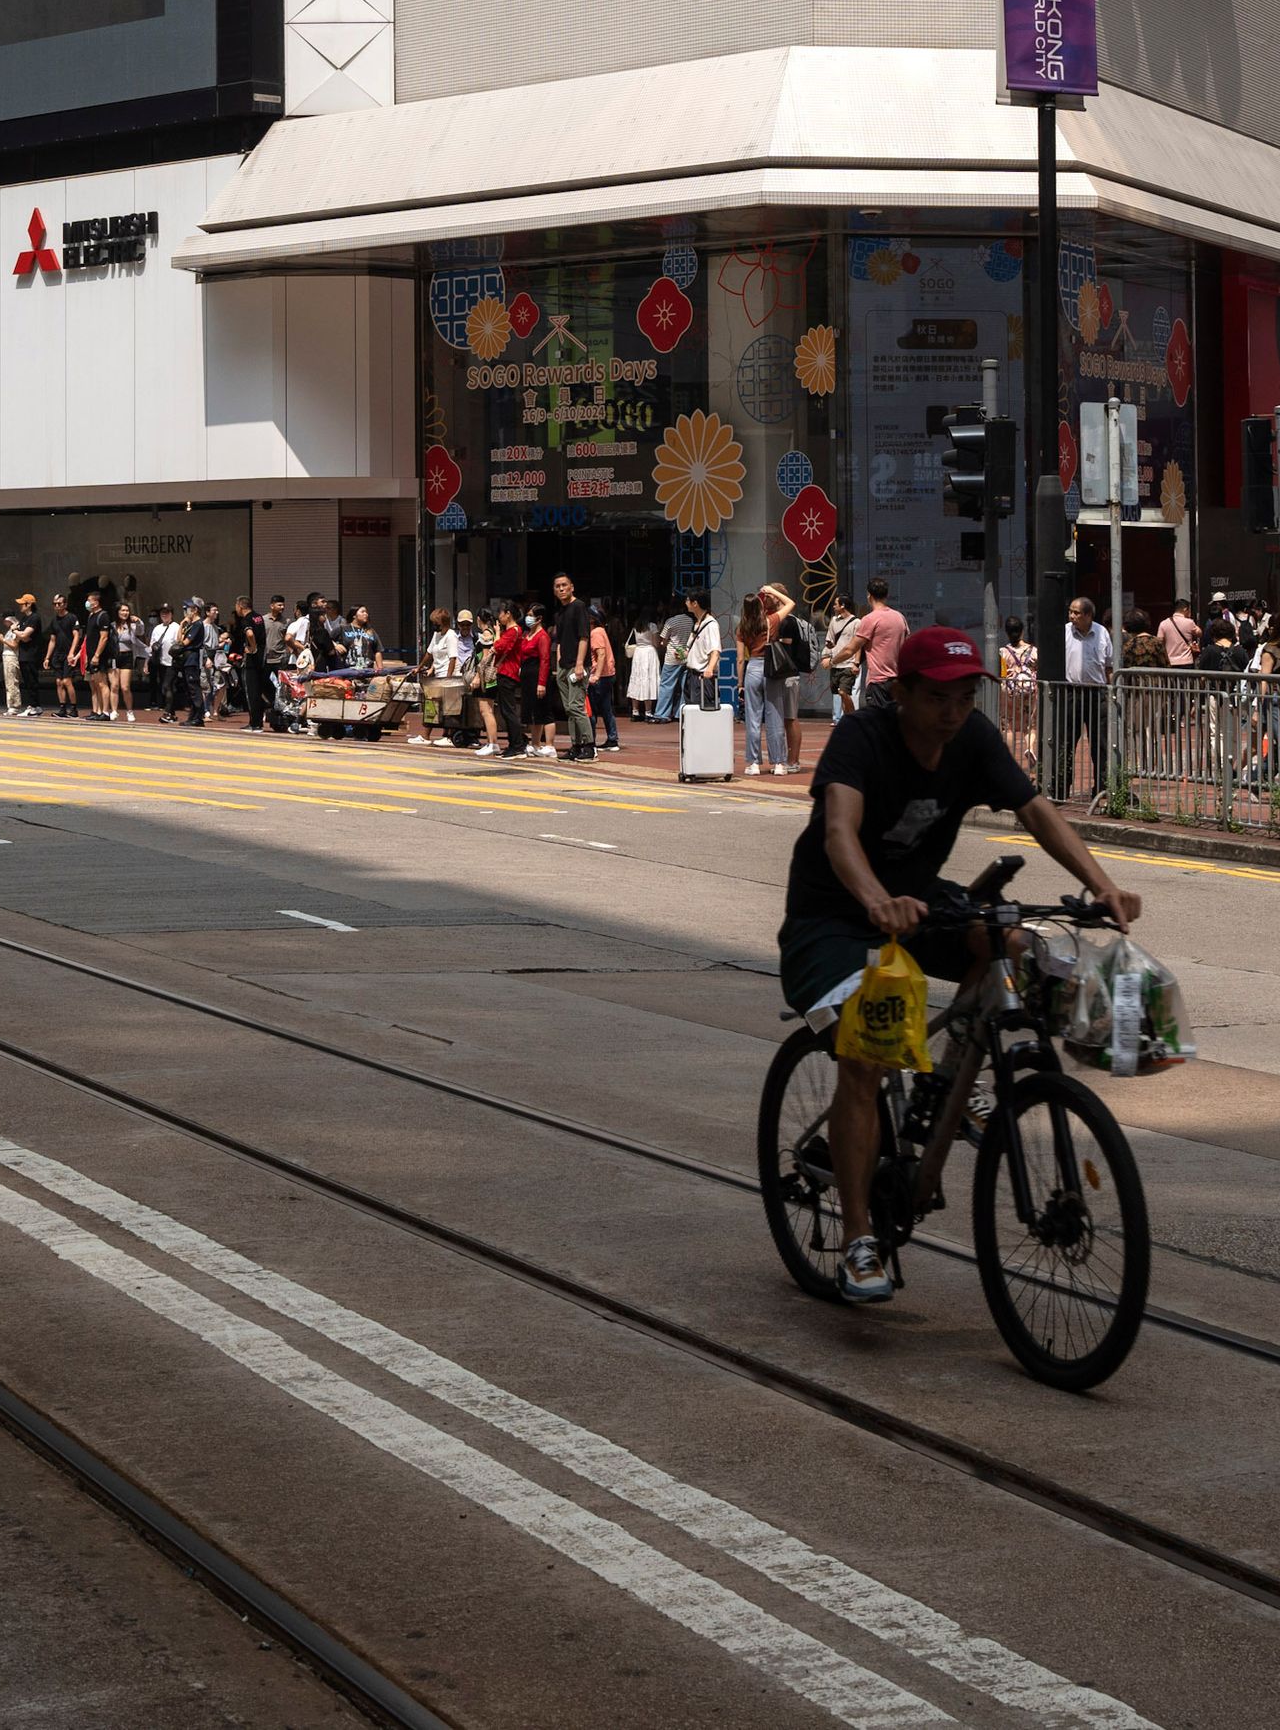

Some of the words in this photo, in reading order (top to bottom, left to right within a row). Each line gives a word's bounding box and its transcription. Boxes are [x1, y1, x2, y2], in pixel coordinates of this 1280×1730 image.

[1033, 35, 1047, 79] CITY
[61, 211, 159, 245] MITSUBISHI
[61, 239, 147, 270] ELECTRIC
[919, 277, 955, 290] SOGO
[466, 363, 520, 390] SOGO
[522, 357, 606, 387] Rewards
[609, 357, 658, 387] Days
[1078, 351, 1108, 379] SOGO
[522, 408, 546, 426] 16/9
[553, 404, 607, 422] 6/10/2024
[124, 534, 194, 555] BURBERRY
